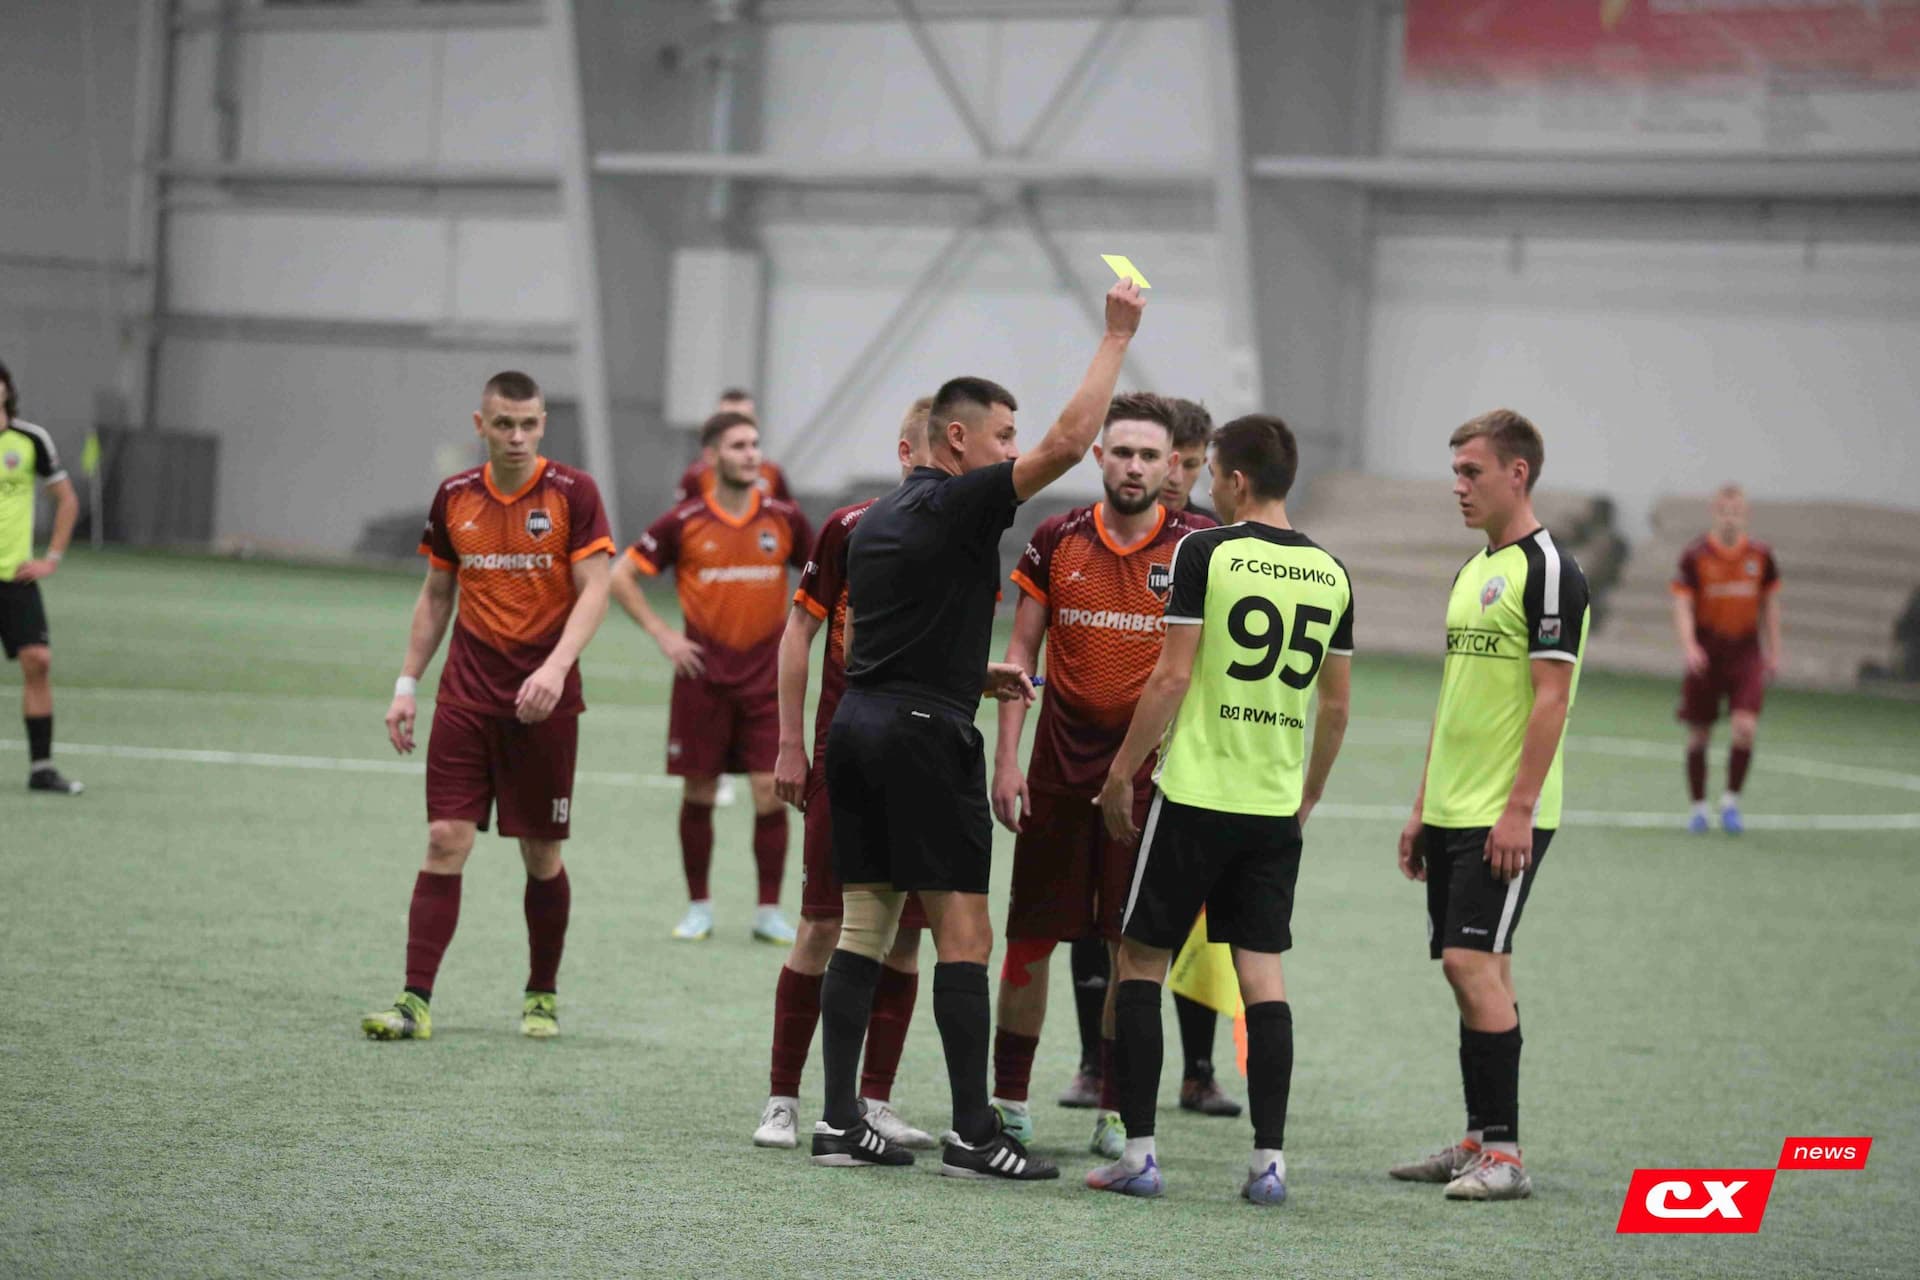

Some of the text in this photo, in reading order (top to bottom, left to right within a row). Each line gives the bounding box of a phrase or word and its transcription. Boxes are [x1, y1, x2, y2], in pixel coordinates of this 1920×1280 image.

[460, 554, 553, 570] РОДИНВЕСТ
[1059, 608, 1168, 632] ПРОДИНВЕС
[1226, 595, 1332, 690] 95
[1243, 707, 1277, 726] RVM
[552, 797, 569, 823] 19
